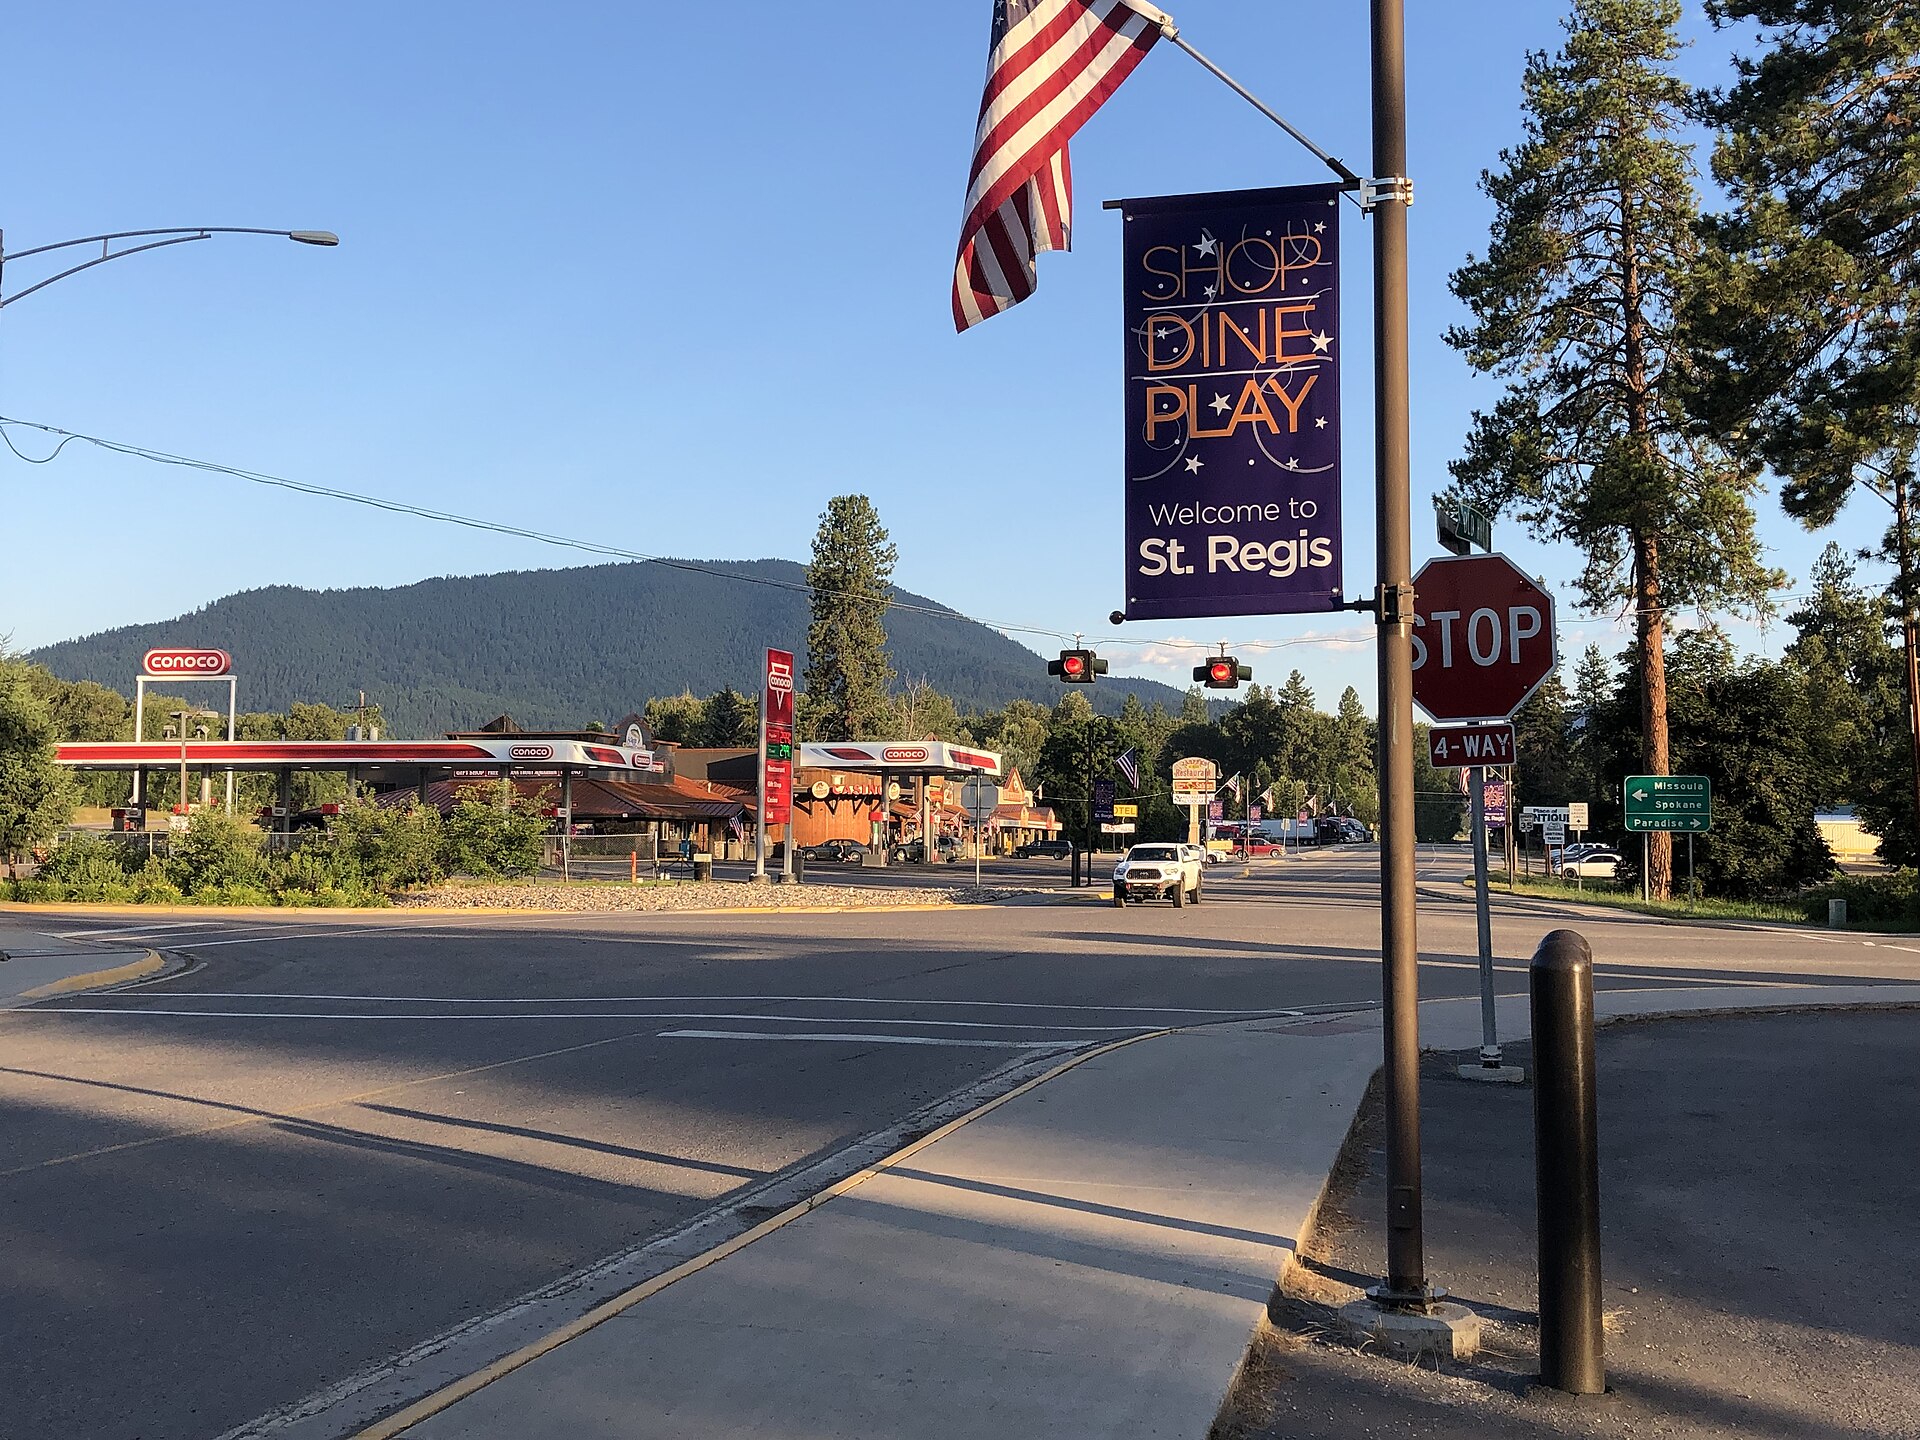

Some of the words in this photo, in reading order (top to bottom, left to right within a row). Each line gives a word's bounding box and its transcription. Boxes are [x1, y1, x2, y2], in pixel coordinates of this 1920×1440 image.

[1141, 235, 1322, 301] SHOP
[1146, 304, 1318, 373] DINE
[1146, 375, 1319, 441] PLAY
[1148, 501, 1281, 527] Welcome
[1288, 497, 1318, 521] to
[1139, 537, 1195, 577] St.
[1207, 529, 1333, 578] Regis
[1411, 605, 1542, 671] STOP
[1433, 733, 1510, 760] 4-WAY
[1654, 781, 1703, 790] Missoula
[1114, 806, 1136, 815] OTEL
[1532, 813, 1570, 822] NTIQU
[1655, 800, 1702, 810] Spokane
[1634, 818, 1684, 828] Paradise
